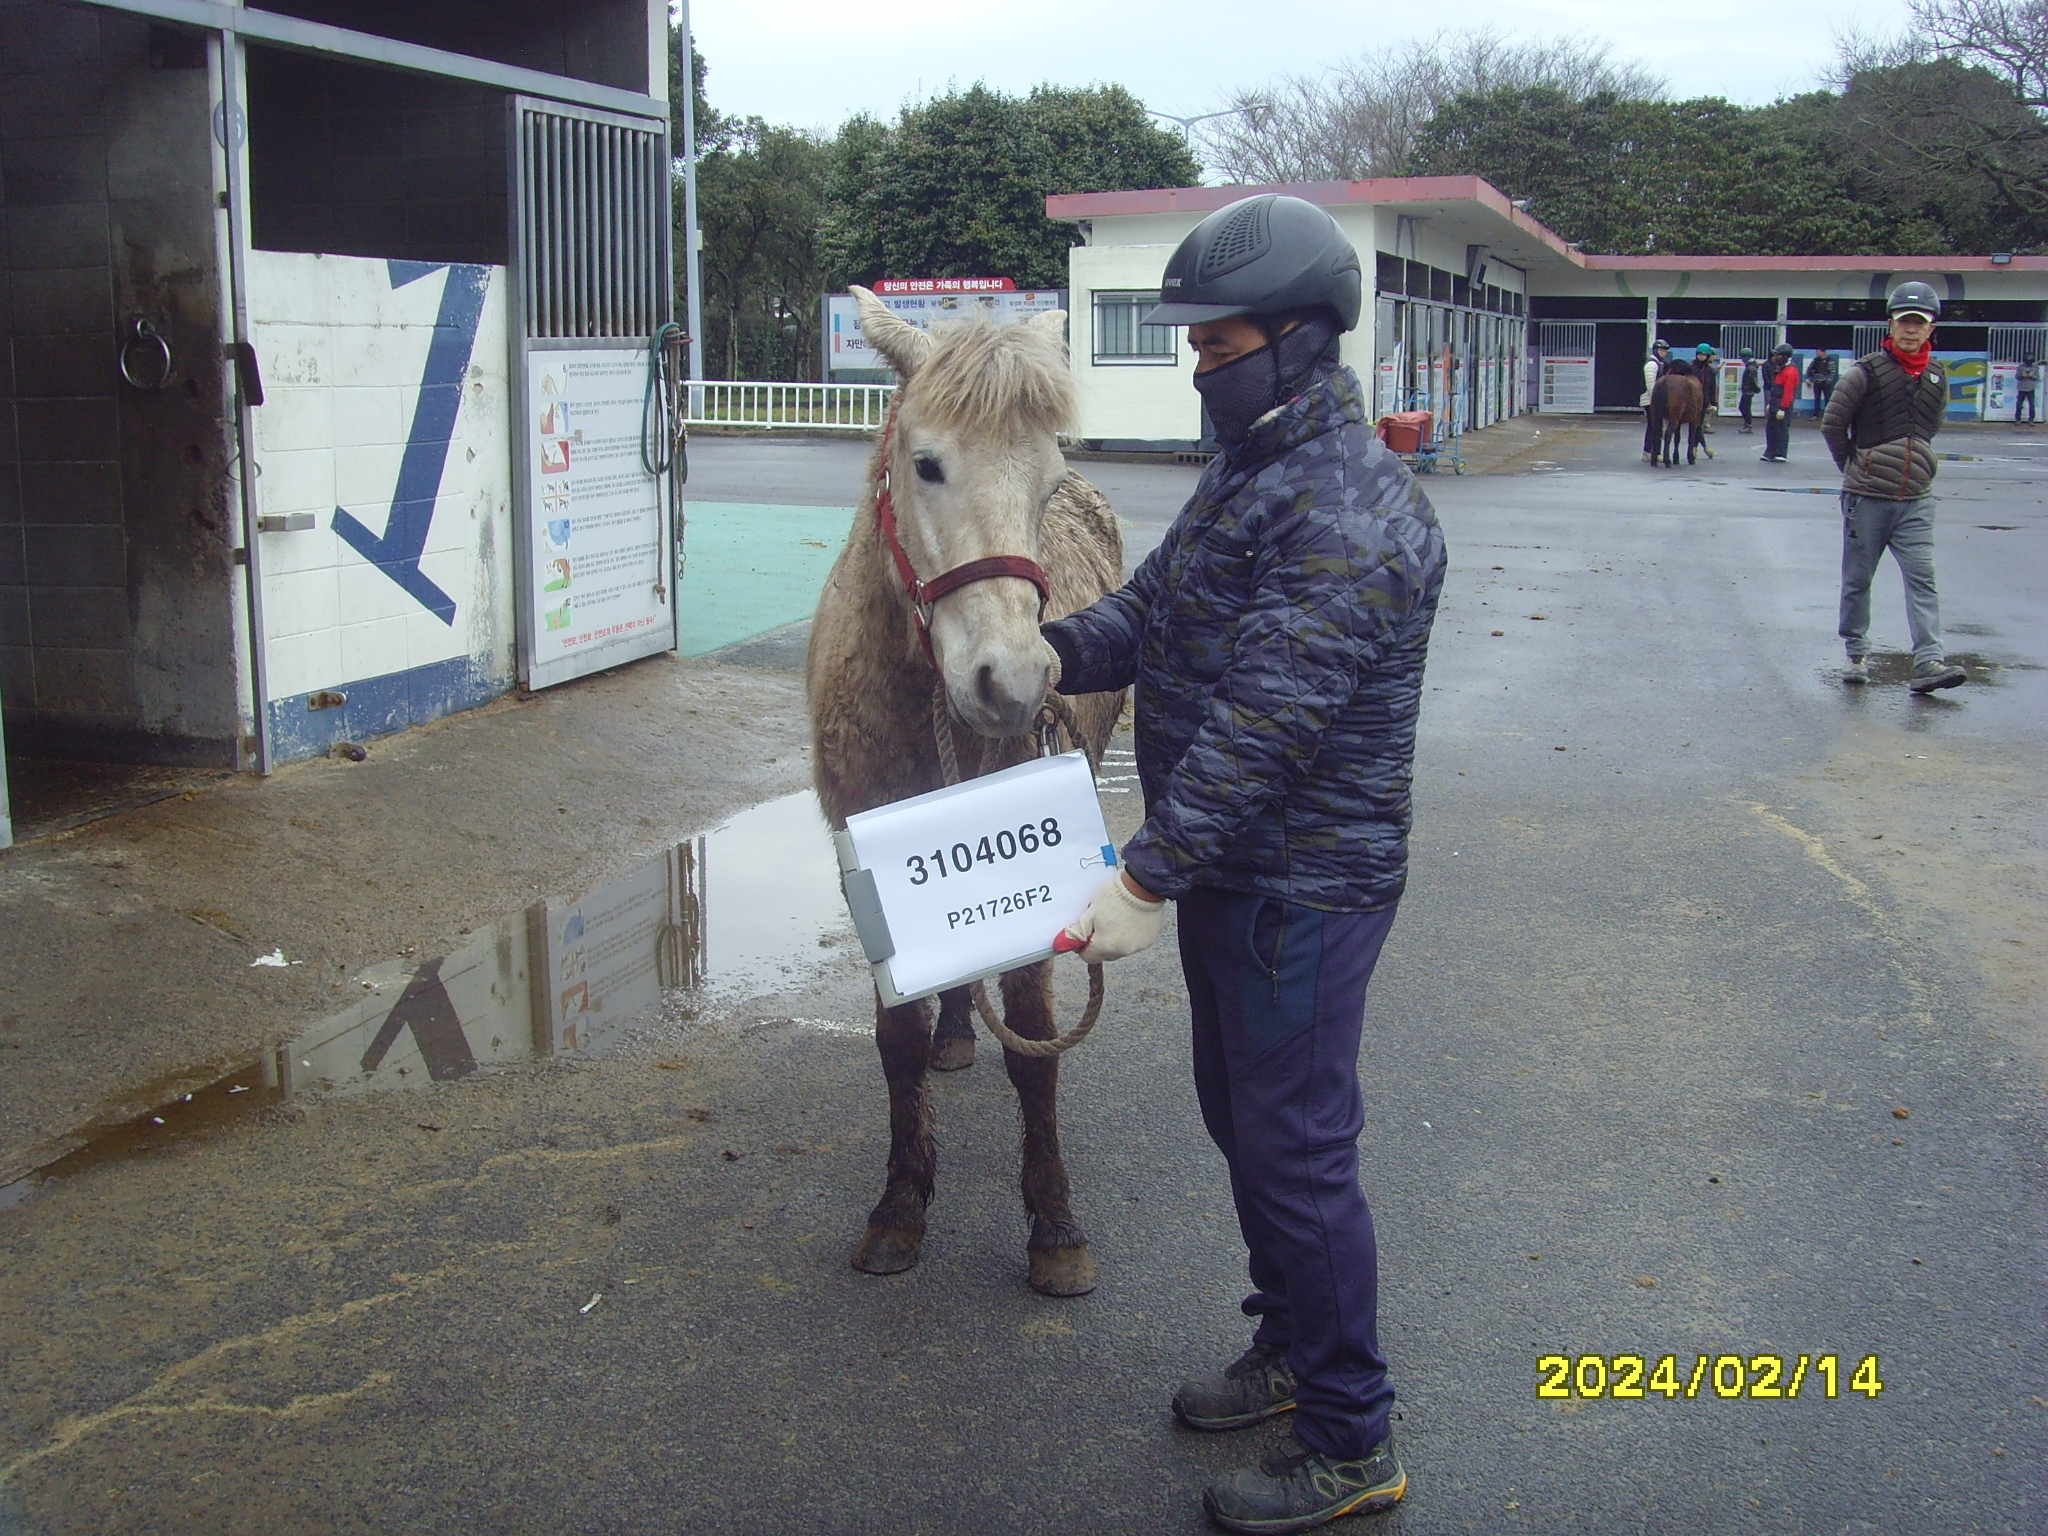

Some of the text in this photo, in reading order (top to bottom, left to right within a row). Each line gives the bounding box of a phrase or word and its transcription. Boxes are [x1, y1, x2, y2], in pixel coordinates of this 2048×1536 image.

[883, 279, 1003, 291] 당신의 안전은 가족의 행복입니다
[893, 298, 926, 309] 발생현황
[906, 817, 1062, 886] 3104068
[947, 884, 1053, 930] P21726F2
